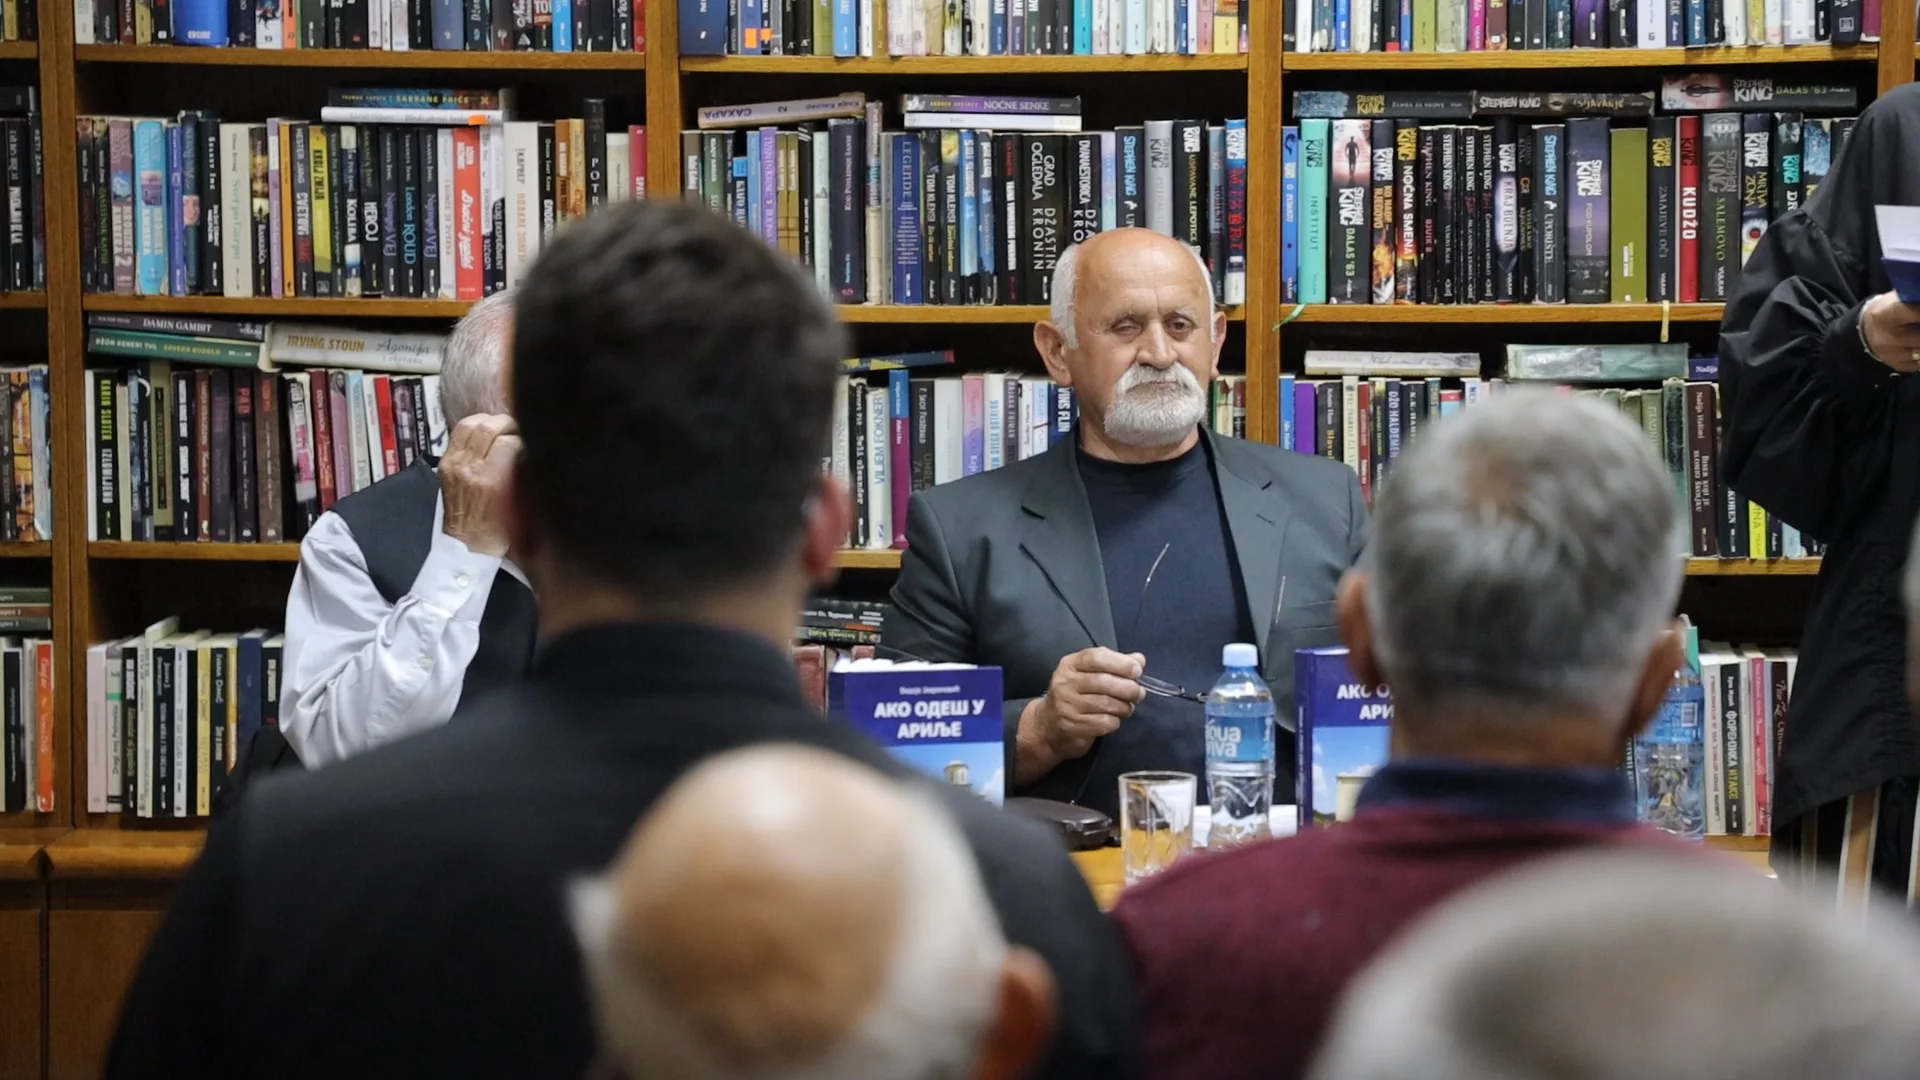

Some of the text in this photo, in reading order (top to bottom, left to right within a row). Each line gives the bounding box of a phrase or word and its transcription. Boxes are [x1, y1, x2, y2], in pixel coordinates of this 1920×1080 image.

[984, 101, 1049, 111] NOĆNE SENKE
[1357, 101, 1385, 114] KING
[1479, 96, 1541, 108] STEPHEN KING
[1734, 88, 1774, 102] KING
[1150, 138, 1164, 169] KING
[1183, 126, 1196, 153] KING
[1226, 128, 1241, 160] KING
[1305, 139, 1318, 168] KING
[1397, 128, 1412, 161] KING
[1424, 134, 1433, 179] STEPHEN
[1442, 134, 1453, 167] STEPHEN
[1498, 143, 1511, 173] KING
[1652, 138, 1666, 167] KING
[1743, 132, 1760, 168] KING
[1757, 131, 1769, 168] STEPHEN
[902, 141, 913, 199] LEGENDE
[1032, 142, 1045, 200] OGLEDALA
[1043, 155, 1056, 186] GRAD
[1079, 140, 1092, 204] DVANAESTORICA
[1123, 135, 1137, 197] STEPHEN KING
[1189, 154, 1197, 199] USPAVANE
[1373, 148, 1387, 181] KING
[1442, 168, 1453, 190] KING
[1465, 135, 1475, 191] STEPHEN KING
[1482, 134, 1493, 190] STEPHEN KING
[1576, 160, 1593, 197] KING
[1591, 159, 1603, 196] STEPHEN
[1708, 150, 1727, 194] KING
[1725, 149, 1738, 193] STEPHEN
[1783, 154, 1796, 183] KING
[926, 173, 937, 222] TOM KLENSI
[946, 174, 957, 223] TOM KLENSI
[1338, 187, 1354, 227] KING
[1352, 186, 1365, 226] STEPHEN
[1373, 187, 1384, 229] NJEGOVO
[1384, 185, 1393, 198] KO
[1424, 181, 1434, 207] KING
[1502, 180, 1515, 206] KRAJ
[1543, 134, 1558, 264] STEPHEN KING UPORIŠTE
[1744, 174, 1757, 209] ZONA
[1756, 170, 1768, 209] MRTVA
[346, 198, 359, 243] KOLIBA
[363, 201, 379, 242] HEROJ
[402, 186, 416, 264] London ROUD
[461, 190, 475, 234] Bračni
[1228, 168, 1244, 250] MIZERI
[1310, 195, 1319, 252] INSTITUT
[1402, 166, 1416, 254] NOĆNA SMENA
[1658, 185, 1668, 237] ZMAJEVE
[1681, 186, 1698, 240] KUDŽO
[382, 233, 397, 257] VEJ
[422, 234, 438, 259] VEJ
[1033, 208, 1045, 270] KRONIN
[1045, 208, 1057, 270] DŽASTIN
[1585, 218, 1593, 256] KUPOLOM
[1715, 196, 1726, 261] SALEMOVO
[113, 255, 132, 267] 2
[1345, 227, 1356, 277] DALAS '63
[1658, 238, 1669, 259] OČI
[143, 317, 174, 329] DAMIN
[288, 335, 430, 356] IRVING STOUN Agonija
[413, 384, 424, 419] NIKOLAS
[1057, 387, 1071, 433] VINS FLIN
[1388, 390, 1402, 409] DŽO
[871, 396, 885, 443] FOKNER
[874, 699, 986, 719] АКО ОДЕШ У
[1359, 704, 1396, 720] АРИ
[897, 721, 962, 739] АРИЉЕ
